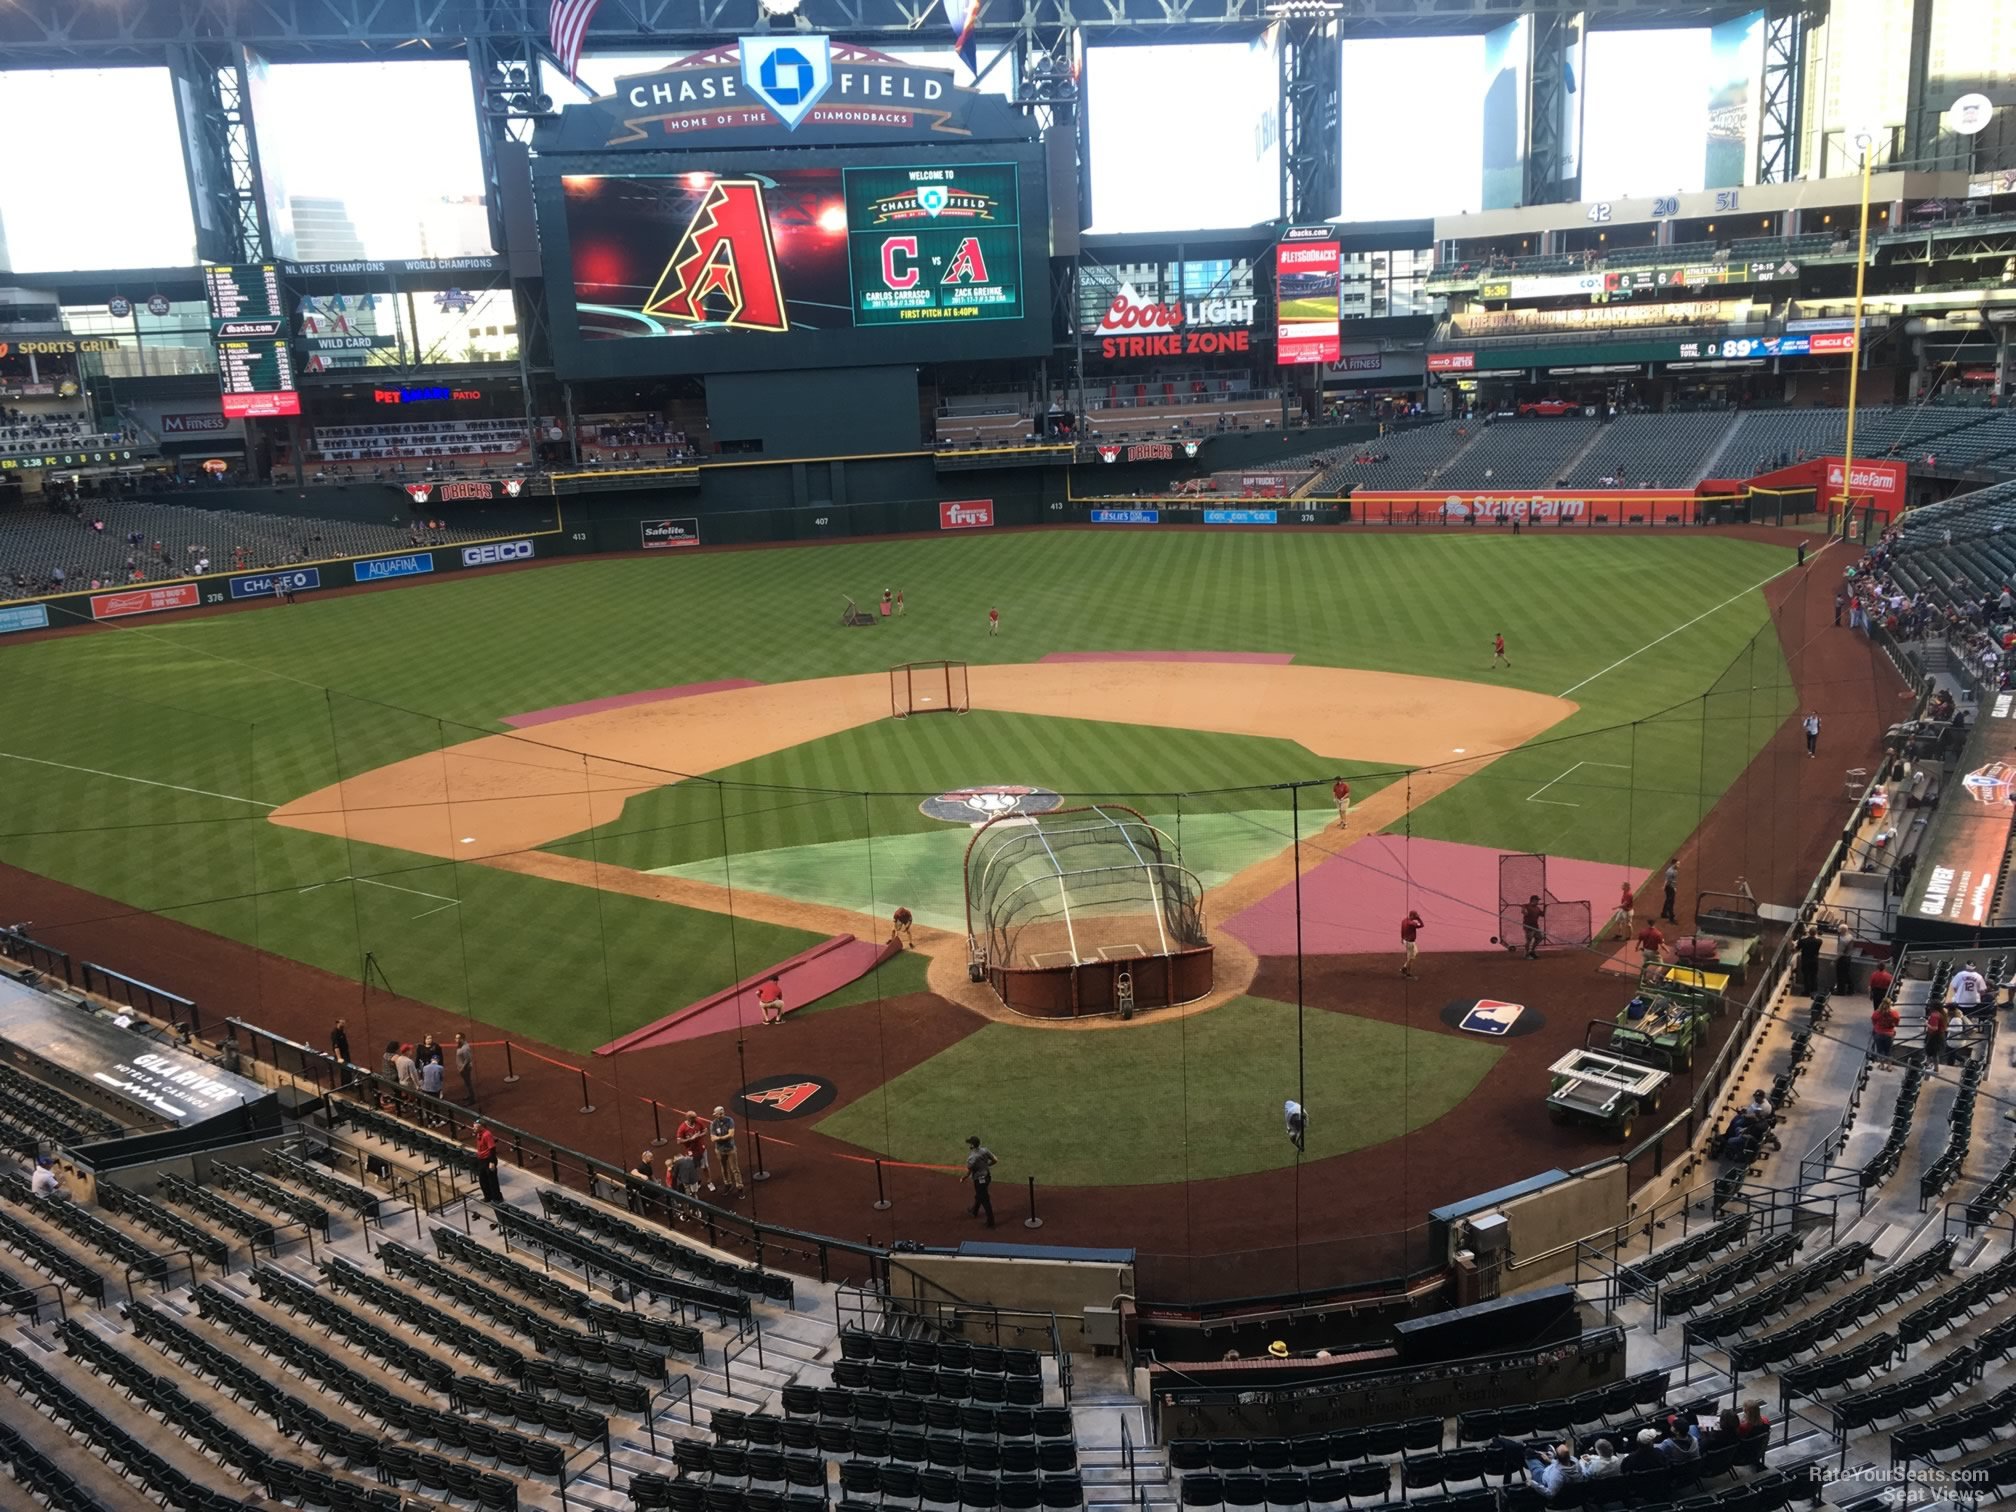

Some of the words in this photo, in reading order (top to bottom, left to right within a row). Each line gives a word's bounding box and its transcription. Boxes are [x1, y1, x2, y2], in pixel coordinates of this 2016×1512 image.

[1274, 10, 1335, 18] CASINOS
[629, 75, 736, 108] CHASE
[841, 73, 943, 101] FIELD
[671, 117, 708, 129] HOME
[717, 113, 733, 124] OF
[743, 112, 767, 122] THE
[814, 111, 908, 124] DIAMONDBACKS
[909, 171, 943, 180] WELCOME
[945, 170, 954, 179] TO
[881, 200, 917, 212] CHASE
[950, 199, 985, 208] FIELD
[1653, 196, 1680, 215] 20
[1716, 191, 1739, 211] 51
[1587, 204, 1612, 222] 42
[1289, 229, 1328, 237] dbacks.com
[285, 265, 297, 274] NL
[301, 264, 326, 274] WEST
[329, 262, 385, 273] CHAMPIONS
[405, 260, 431, 270] WORLD
[433, 258, 492, 269] CHAMPIONS
[1621, 276, 1629, 287] 6
[1658, 273, 1667, 284] 6
[1759, 273, 1774, 281] OUT
[866, 292, 892, 301] CARLOS
[894, 290, 930, 299] CARRASCO
[955, 288, 971, 296] ZACK
[973, 287, 1002, 296] GREINKE
[1484, 285, 1508, 297] 5:36
[901, 310, 920, 319] FIRST
[922, 309, 942, 317] PITCH
[943, 308, 952, 316] AT
[953, 307, 978, 316] 6:40PM
[1102, 294, 1184, 330] Coors
[1186, 299, 1258, 325] LIGHT
[226, 325, 273, 333] dbacks.com
[18, 341, 76, 354] SPORTS
[80, 339, 120, 352] GRILL
[319, 338, 343, 348] WILD
[346, 338, 371, 347] CARD
[1102, 334, 1182, 359] STRIKE
[1186, 330, 1249, 354] ZONE
[1814, 339, 1841, 347] CIRCLE
[1708, 344, 1716, 355] 0
[1350, 359, 1380, 369] FITNESS
[453, 391, 480, 399] PATIO
[186, 419, 224, 430] FITNESS
[2, 460, 17, 469] ERA
[23, 459, 42, 468] 3.38
[46, 456, 57, 465] PC
[65, 456, 72, 464] 0
[95, 453, 101, 461] 0
[109, 453, 116, 461] S
[124, 451, 130, 459] 0
[440, 483, 493, 501] DBACKS
[947, 504, 988, 524] fry's
[1301, 514, 1314, 522] 376
[645, 527, 684, 536] Safelite
[464, 541, 533, 564] GEICO
[368, 558, 419, 577] AQUAFINA
[207, 593, 224, 603] 376
[1965, 982, 1974, 991] 12
[133, 1054, 182, 1079] GILA
[174, 1069, 238, 1100] RIVER
[113, 1063, 153, 1083] HOTELS
[161, 1085, 208, 1109] CASINOS
